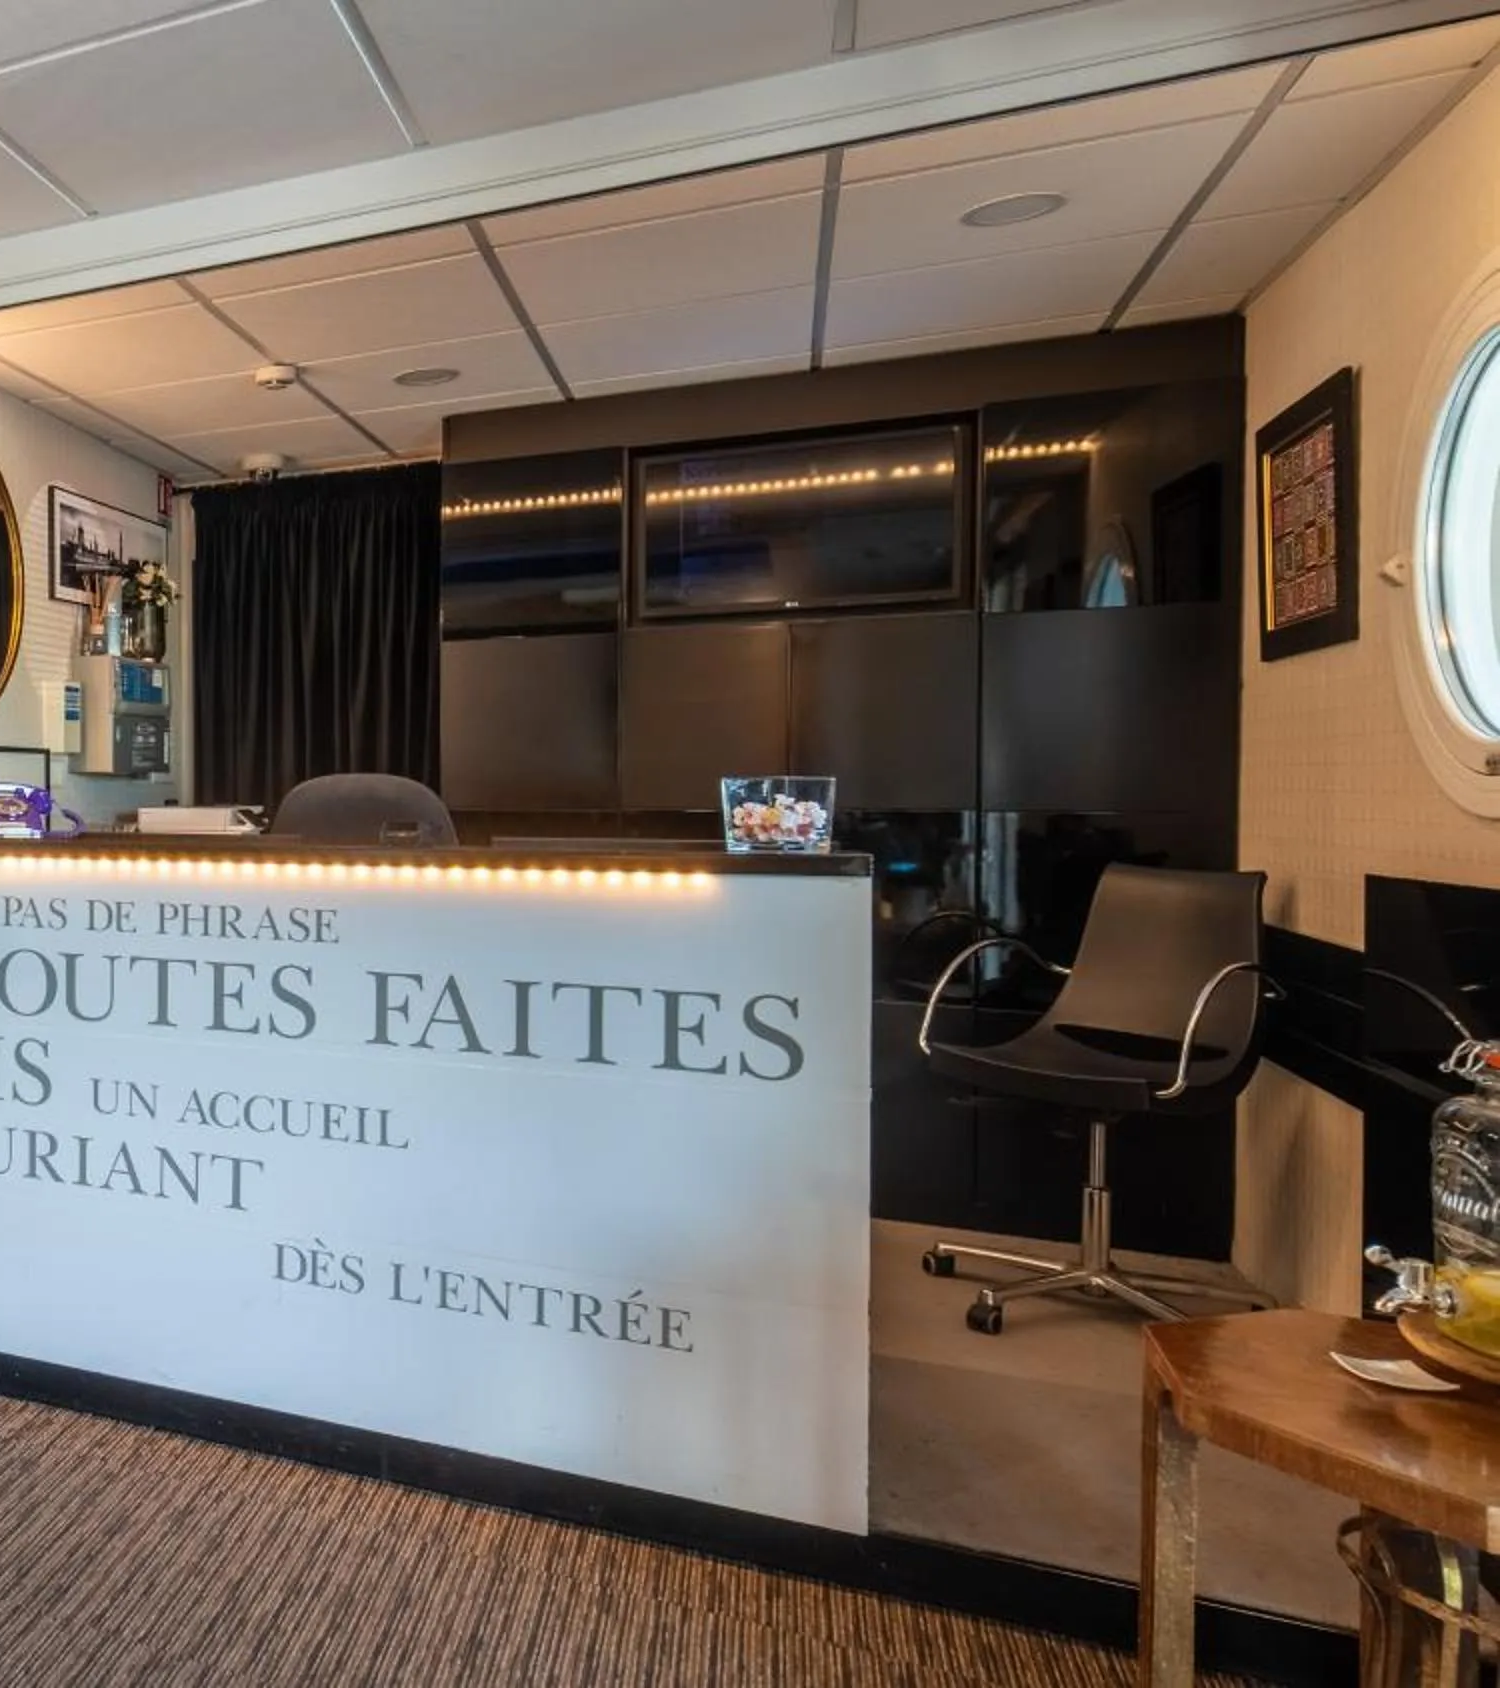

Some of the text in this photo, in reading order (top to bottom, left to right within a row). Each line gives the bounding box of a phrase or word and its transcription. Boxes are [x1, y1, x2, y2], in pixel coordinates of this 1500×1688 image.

[3, 895, 68, 930] PAS
[86, 899, 138, 934] DE
[156, 901, 341, 944] PHRASE
[364, 971, 805, 1082] FAITES
[90, 1077, 163, 1120] UN
[177, 1087, 410, 1151] ACCUEIL
[273, 1237, 695, 1354] DÈS L'ENTRÉE
